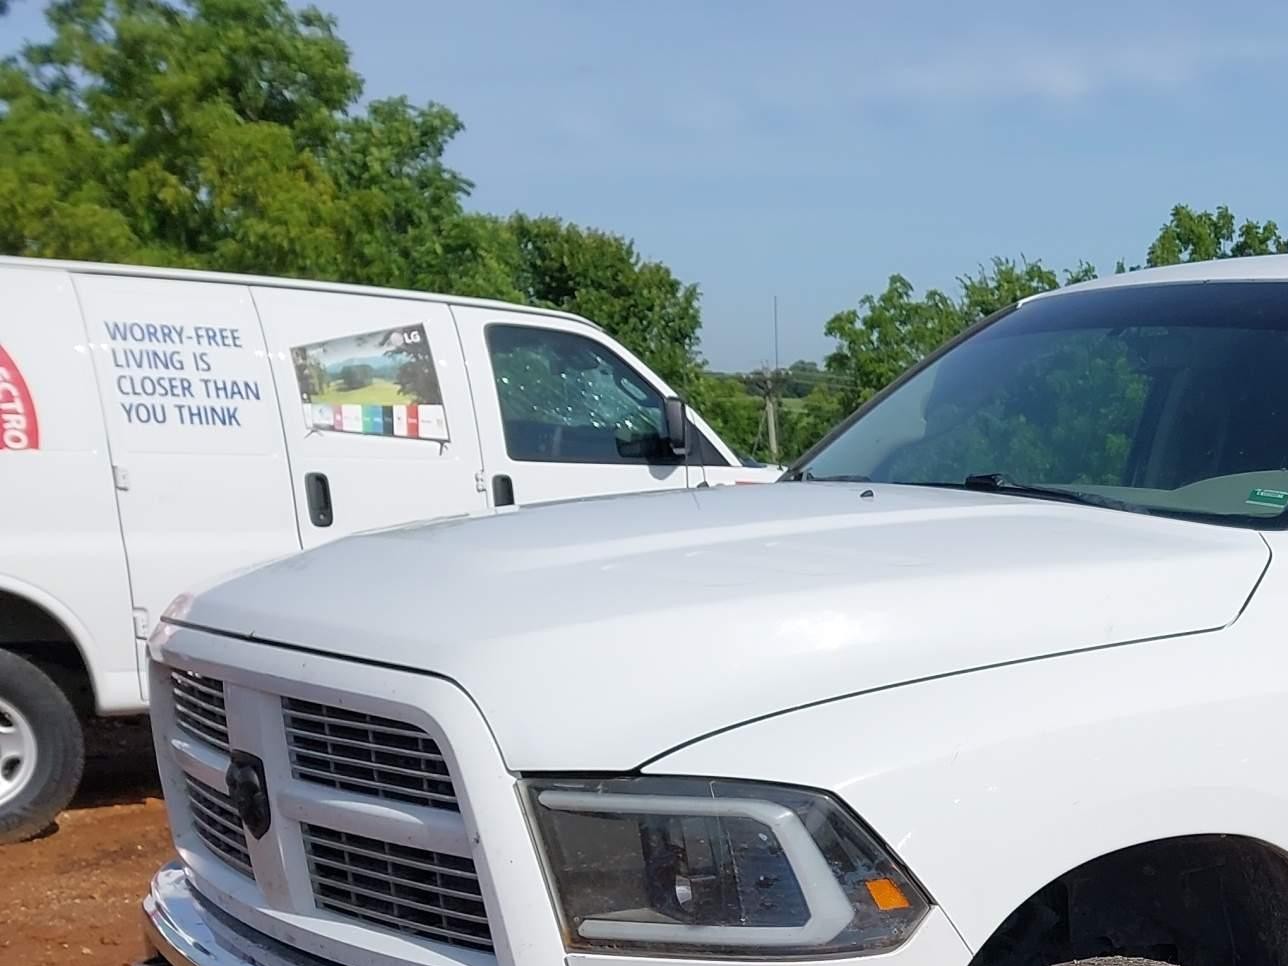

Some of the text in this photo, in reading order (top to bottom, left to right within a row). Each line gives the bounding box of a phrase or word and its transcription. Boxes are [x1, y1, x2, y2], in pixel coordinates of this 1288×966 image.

[104, 320, 242, 348] WORRY-FREE
[403, 331, 421, 344] LG
[111, 348, 212, 372] LIVING IS
[117, 375, 261, 401] CLOSER THAN
[121, 402, 241, 427] YOU THINK
